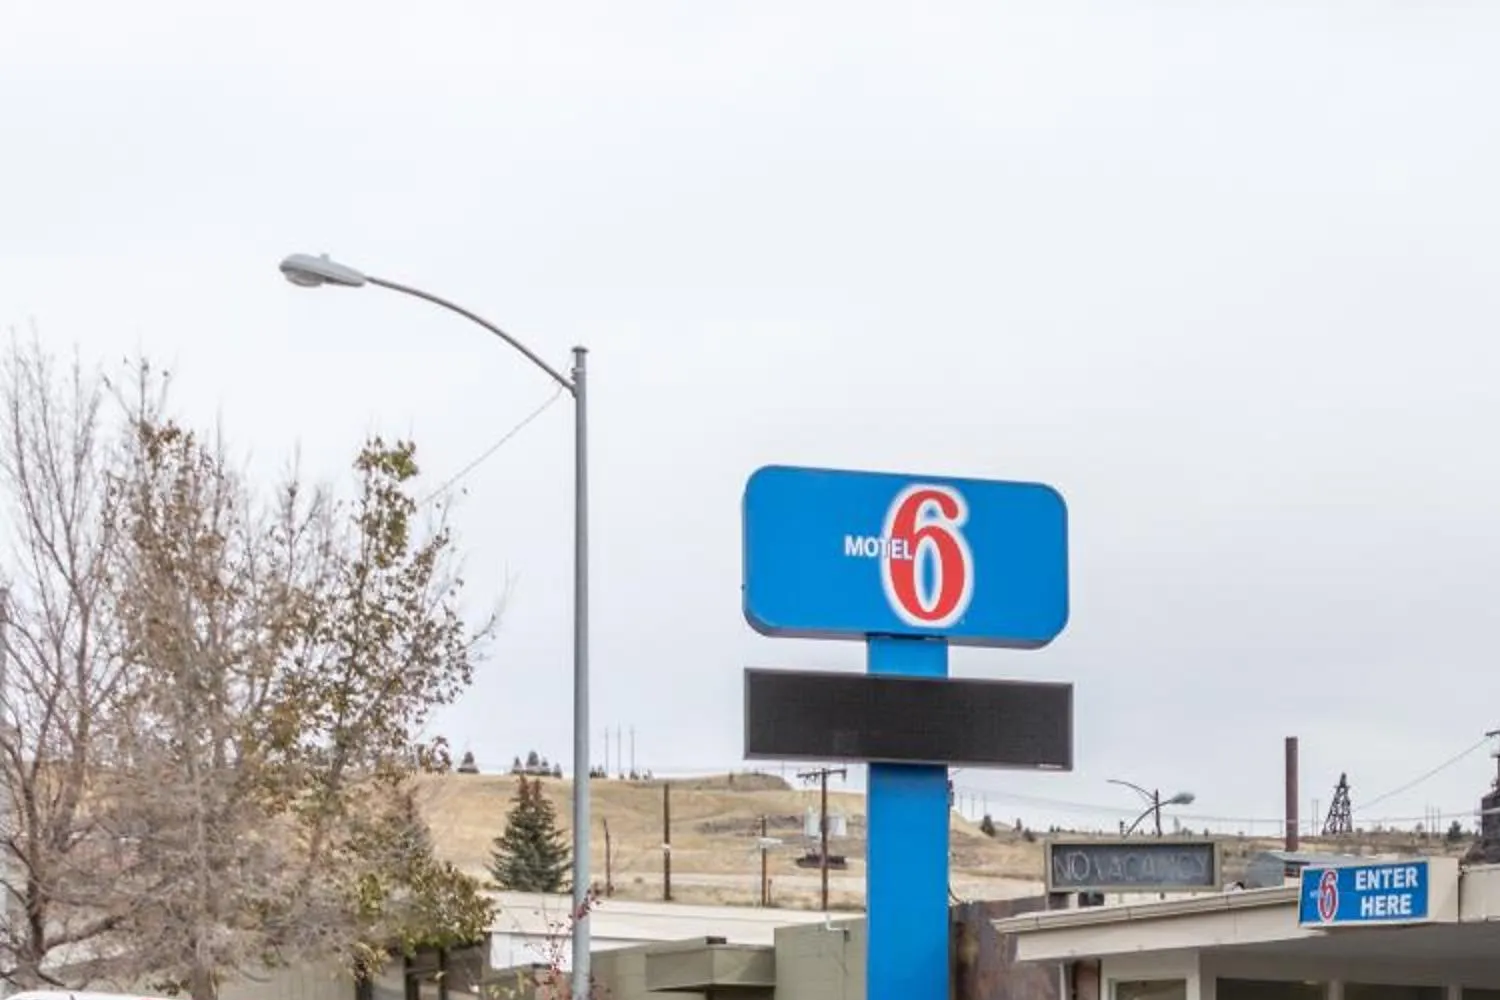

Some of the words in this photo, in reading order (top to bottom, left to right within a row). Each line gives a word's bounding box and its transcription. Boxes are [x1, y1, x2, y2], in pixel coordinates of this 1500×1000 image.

[844, 535, 913, 560] MOTEL
[882, 484, 974, 629] 6
[1053, 850, 1090, 881] NO
[1355, 866, 1419, 891] ENTER
[1318, 869, 1339, 924] 6
[1361, 893, 1412, 917] HERE
